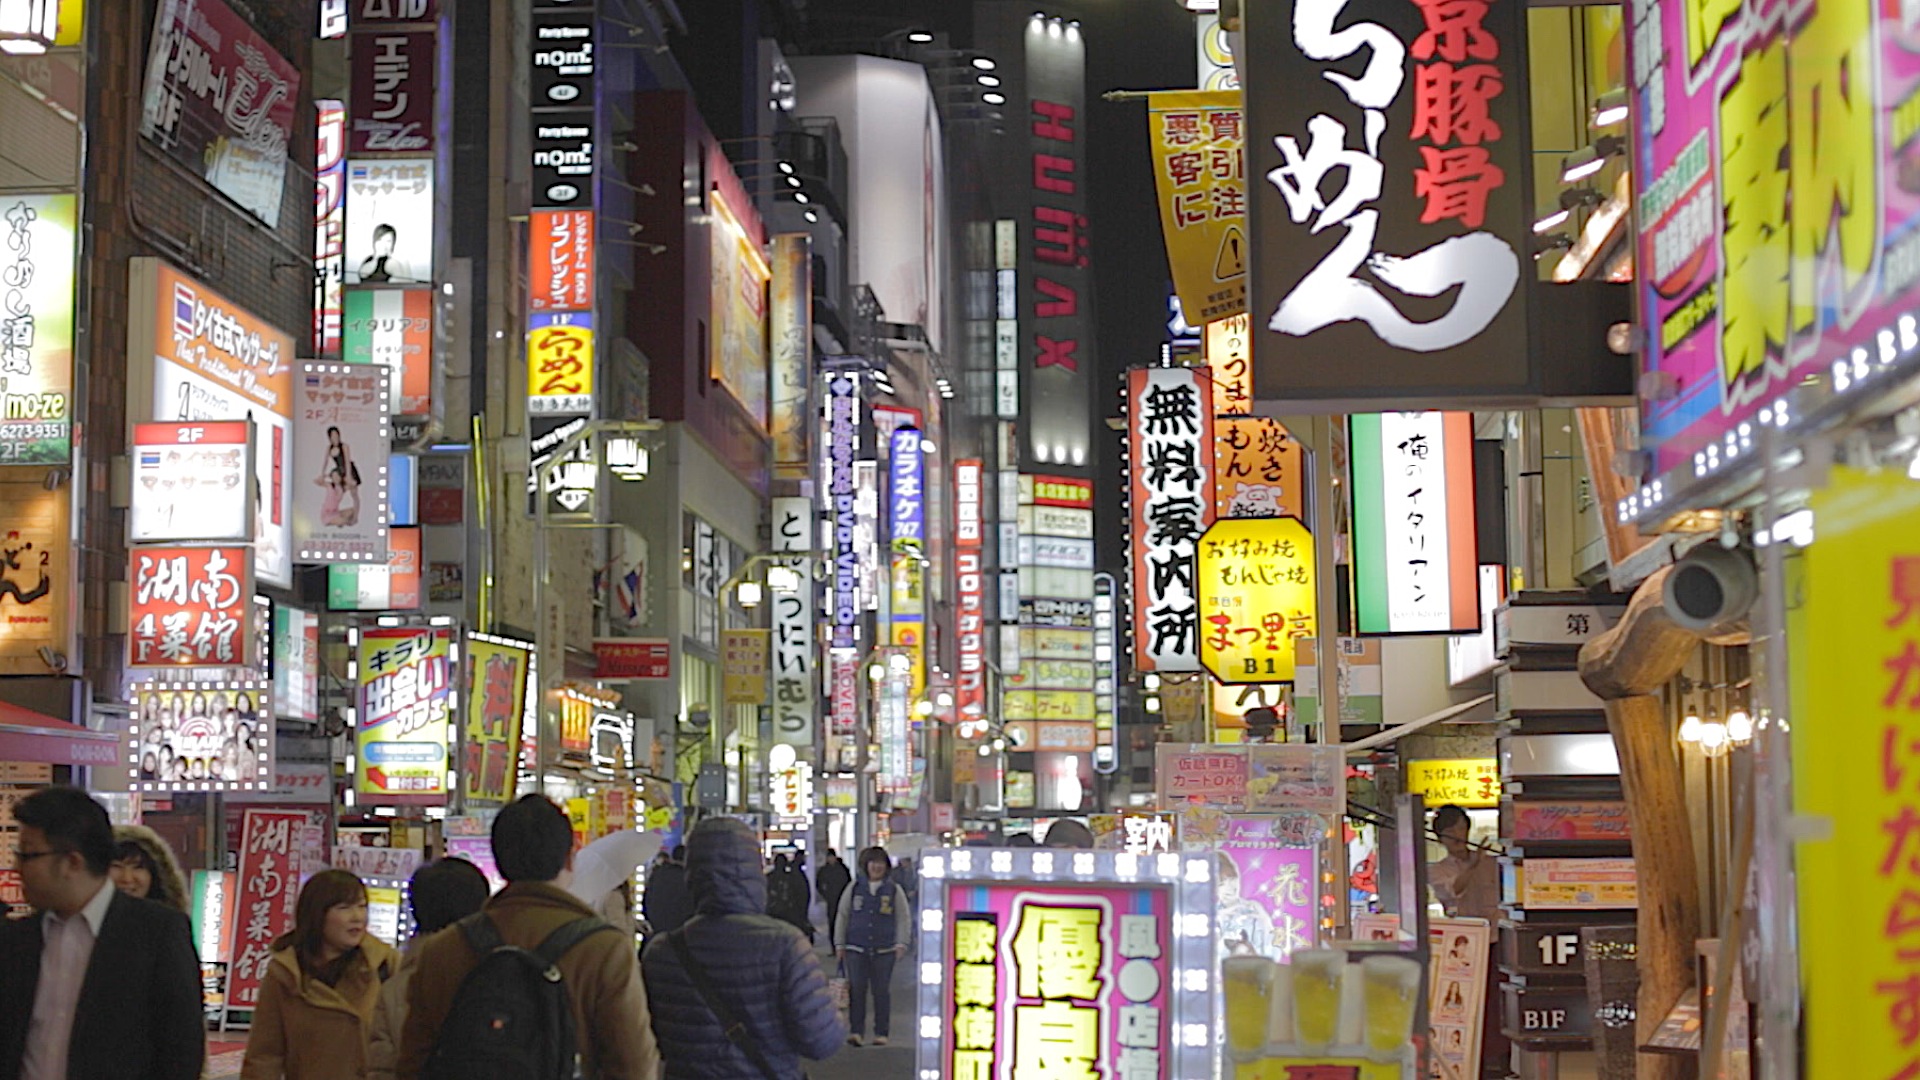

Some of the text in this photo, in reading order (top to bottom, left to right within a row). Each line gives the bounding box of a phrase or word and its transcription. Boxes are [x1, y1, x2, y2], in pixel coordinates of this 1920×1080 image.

[549, 213, 571, 308] リフレッシュ
[178, 427, 204, 443] 2F
[1257, 418, 1287, 482] 炊き
[894, 433, 919, 519] カラオケ
[1144, 384, 1200, 658] 無料案内所
[1396, 433, 1429, 603] 俺のイタリアン
[138, 549, 240, 611] 湖南
[369, 632, 434, 672] キラリ
[365, 658, 444, 723] 出会い
[396, 697, 446, 741] カフェ
[1538, 934, 1578, 964] 1F
[954, 918, 998, 1080] 歌舞伎町
[1012, 902, 1103, 1080] 優良
[1524, 1009, 1566, 1029] B1F
